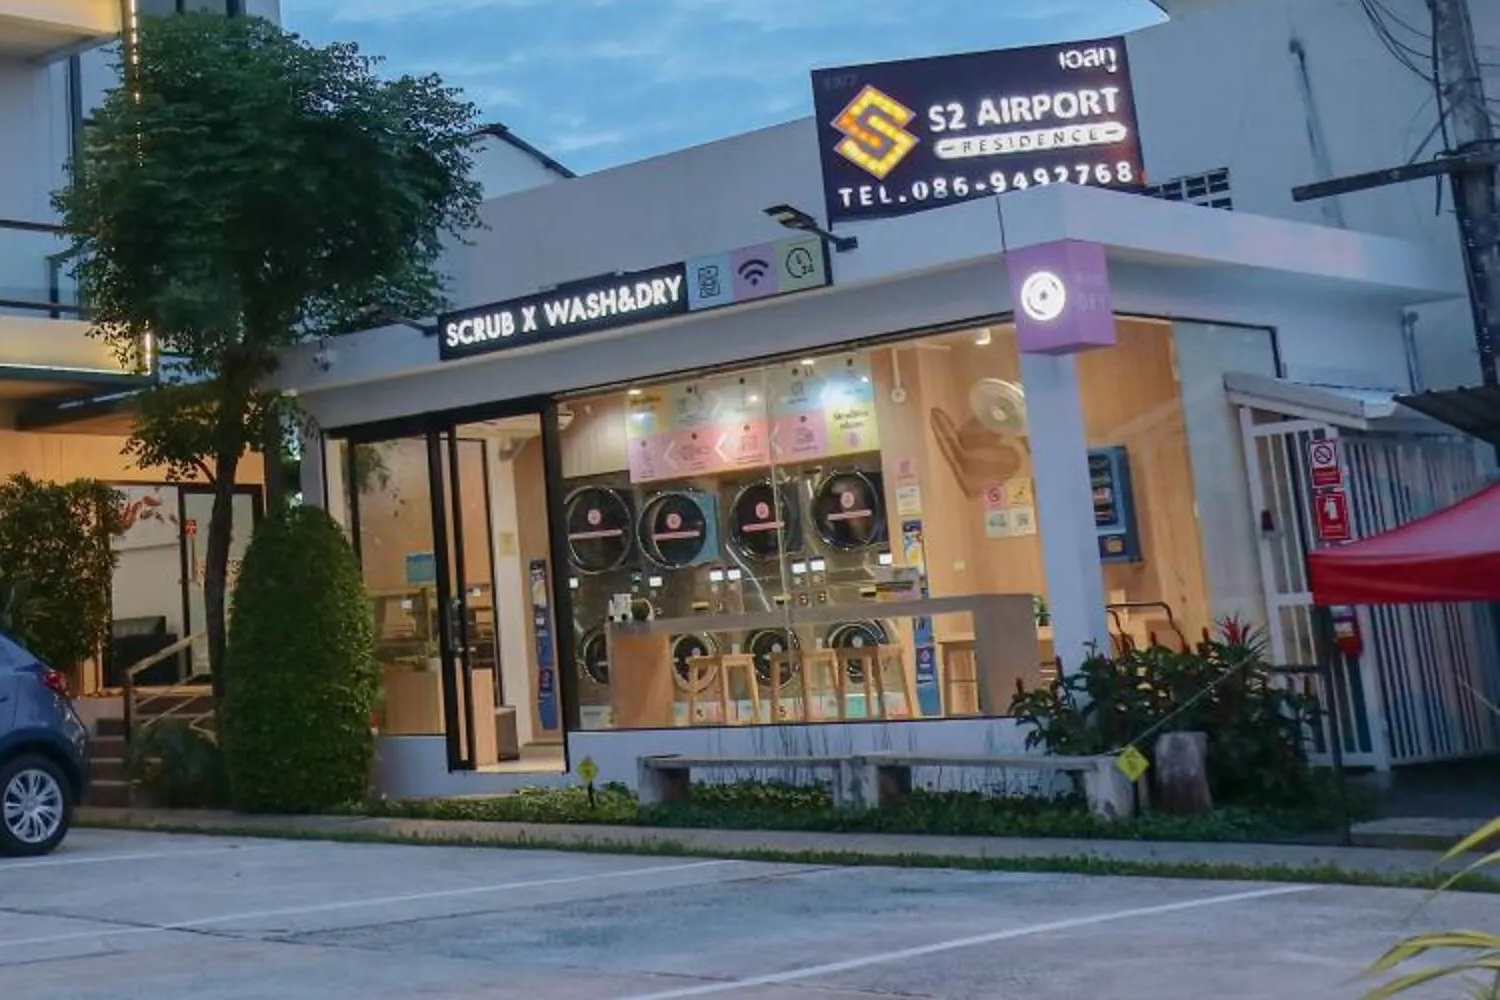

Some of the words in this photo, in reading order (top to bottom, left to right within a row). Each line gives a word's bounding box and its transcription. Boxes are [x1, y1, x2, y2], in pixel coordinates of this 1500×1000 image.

[928, 102, 967, 132] S2
[977, 87, 1119, 126] AIRPORT
[962, 128, 1099, 154] RESIDENCE
[446, 311, 515, 348] SCRUB
[521, 305, 538, 333] X
[544, 275, 683, 328] WASH&DRY
